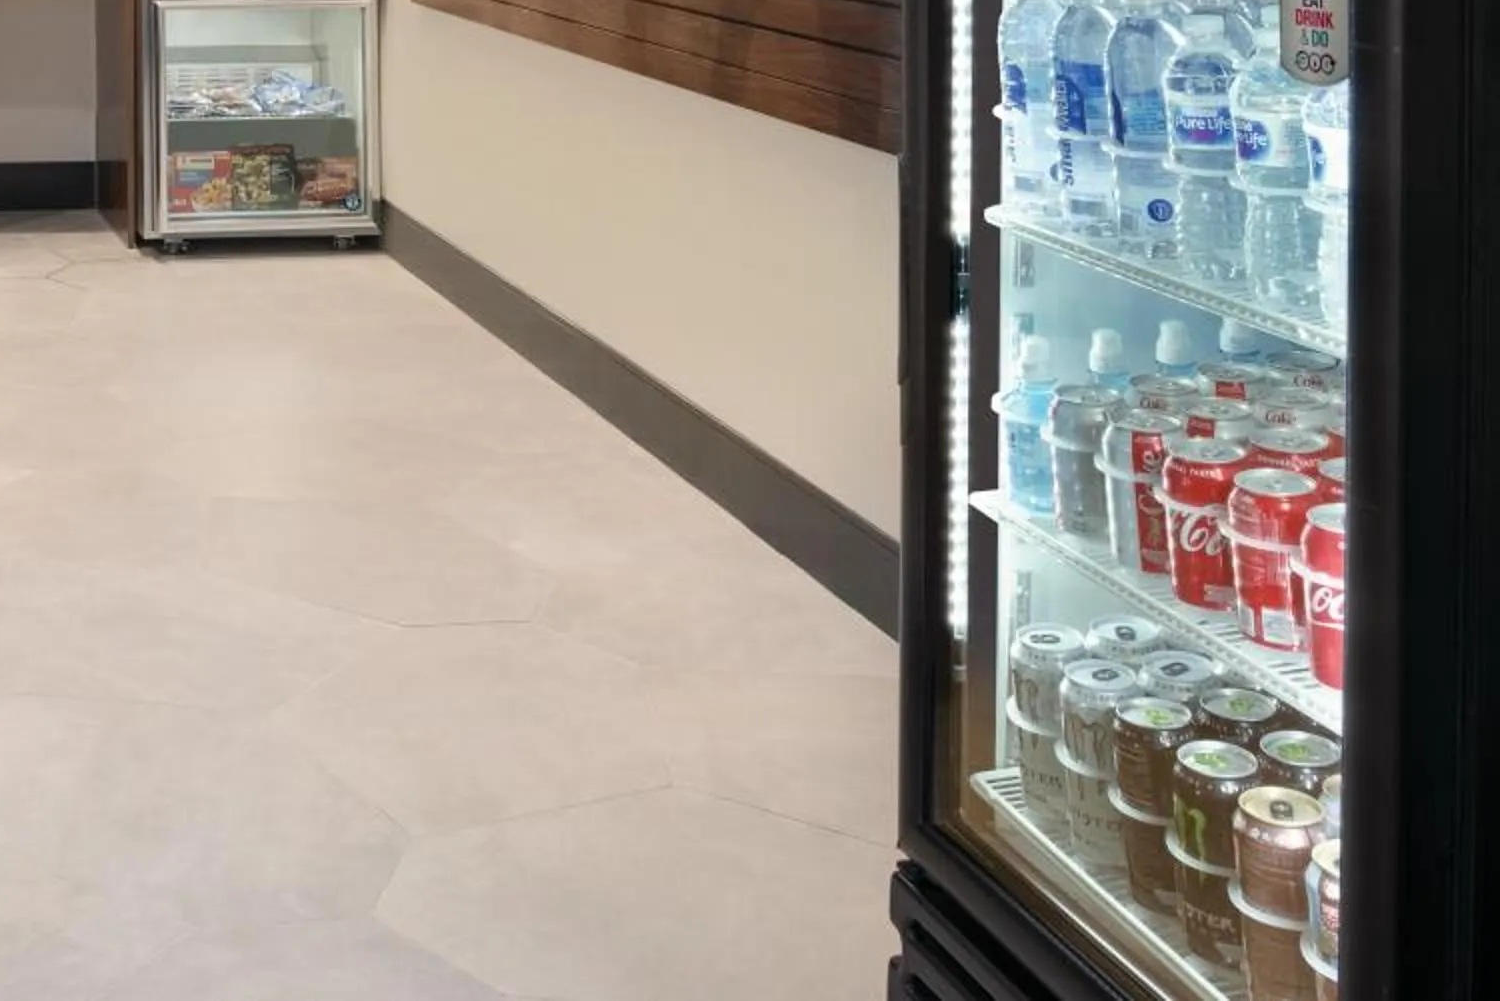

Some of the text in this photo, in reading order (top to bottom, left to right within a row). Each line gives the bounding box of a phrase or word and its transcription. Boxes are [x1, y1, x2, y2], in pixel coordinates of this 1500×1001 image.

[1295, 8, 1334, 30] DRINK
[1176, 115, 1206, 131] Pure
[1207, 115, 1232, 136] Life
